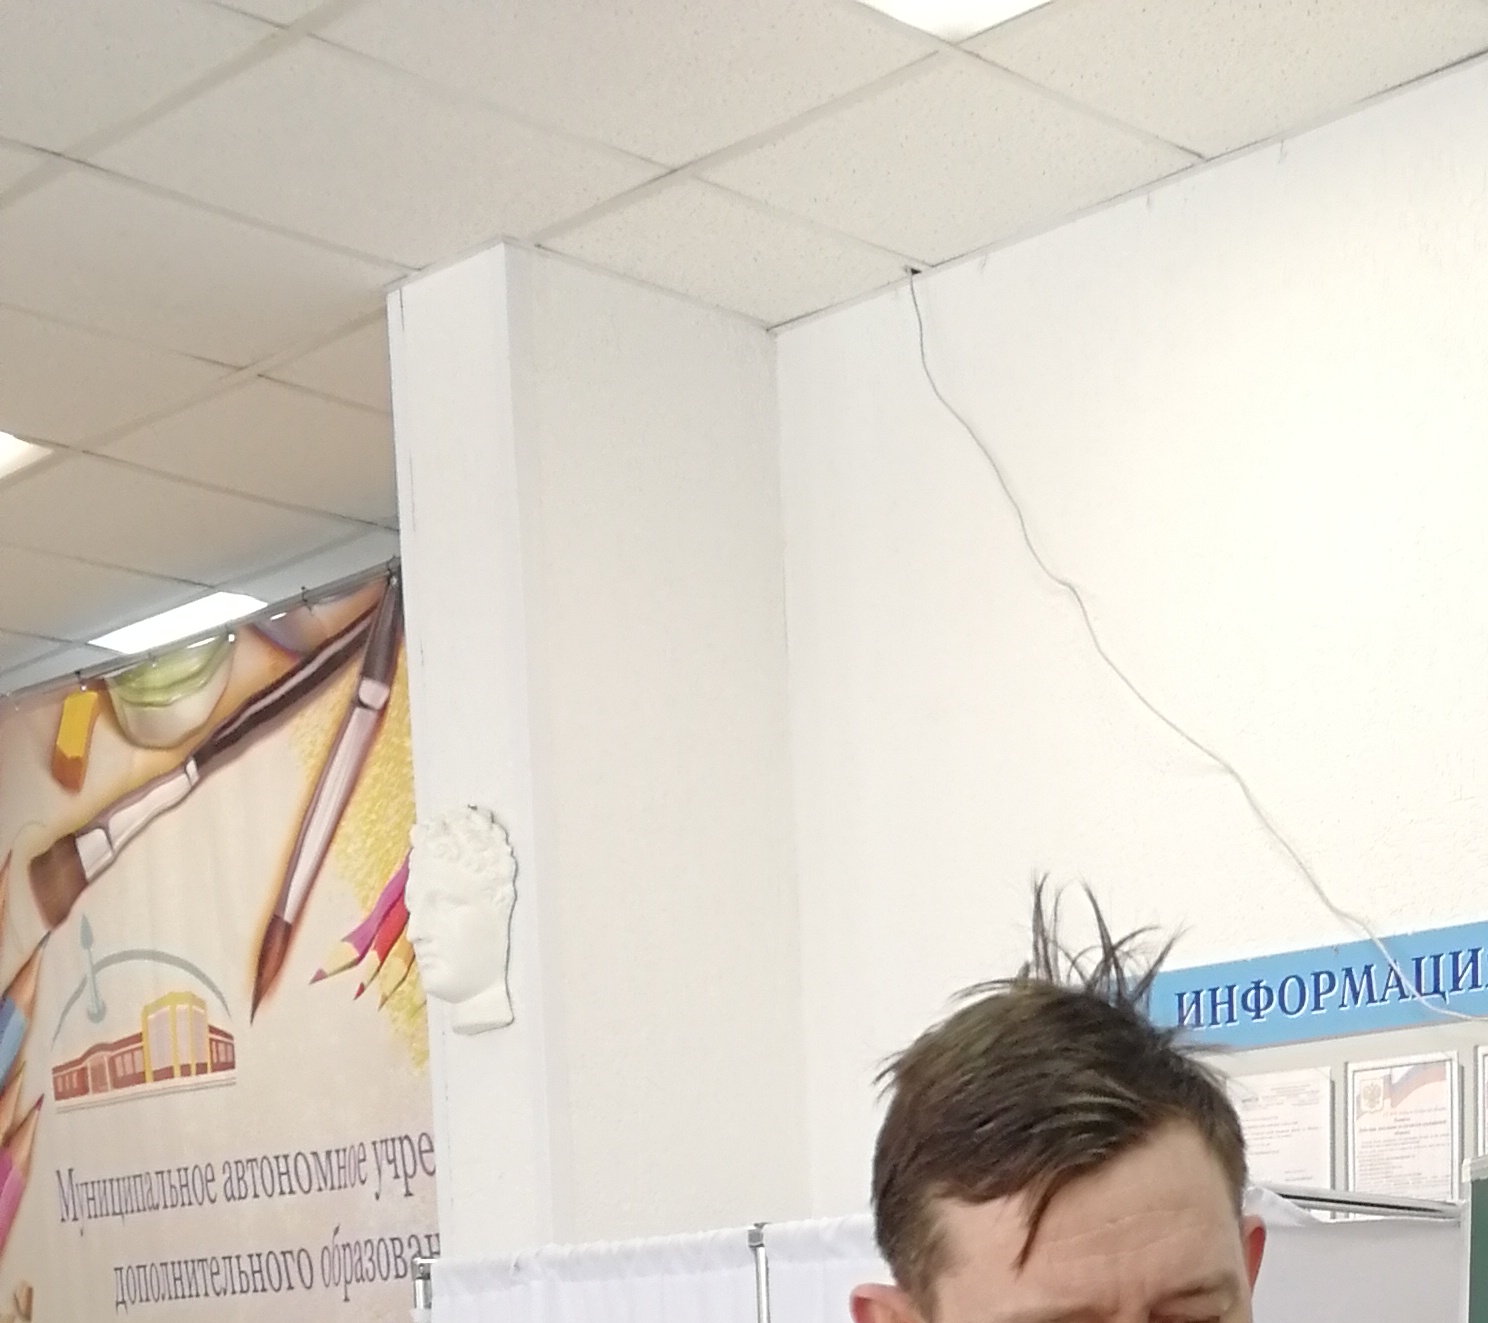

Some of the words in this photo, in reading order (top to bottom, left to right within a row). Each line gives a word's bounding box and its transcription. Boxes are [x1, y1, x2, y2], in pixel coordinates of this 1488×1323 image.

[55, 1162, 218, 1238] Муниципальное
[222, 1141, 368, 1203] автономное
[113, 1247, 314, 1315] дополнительного
